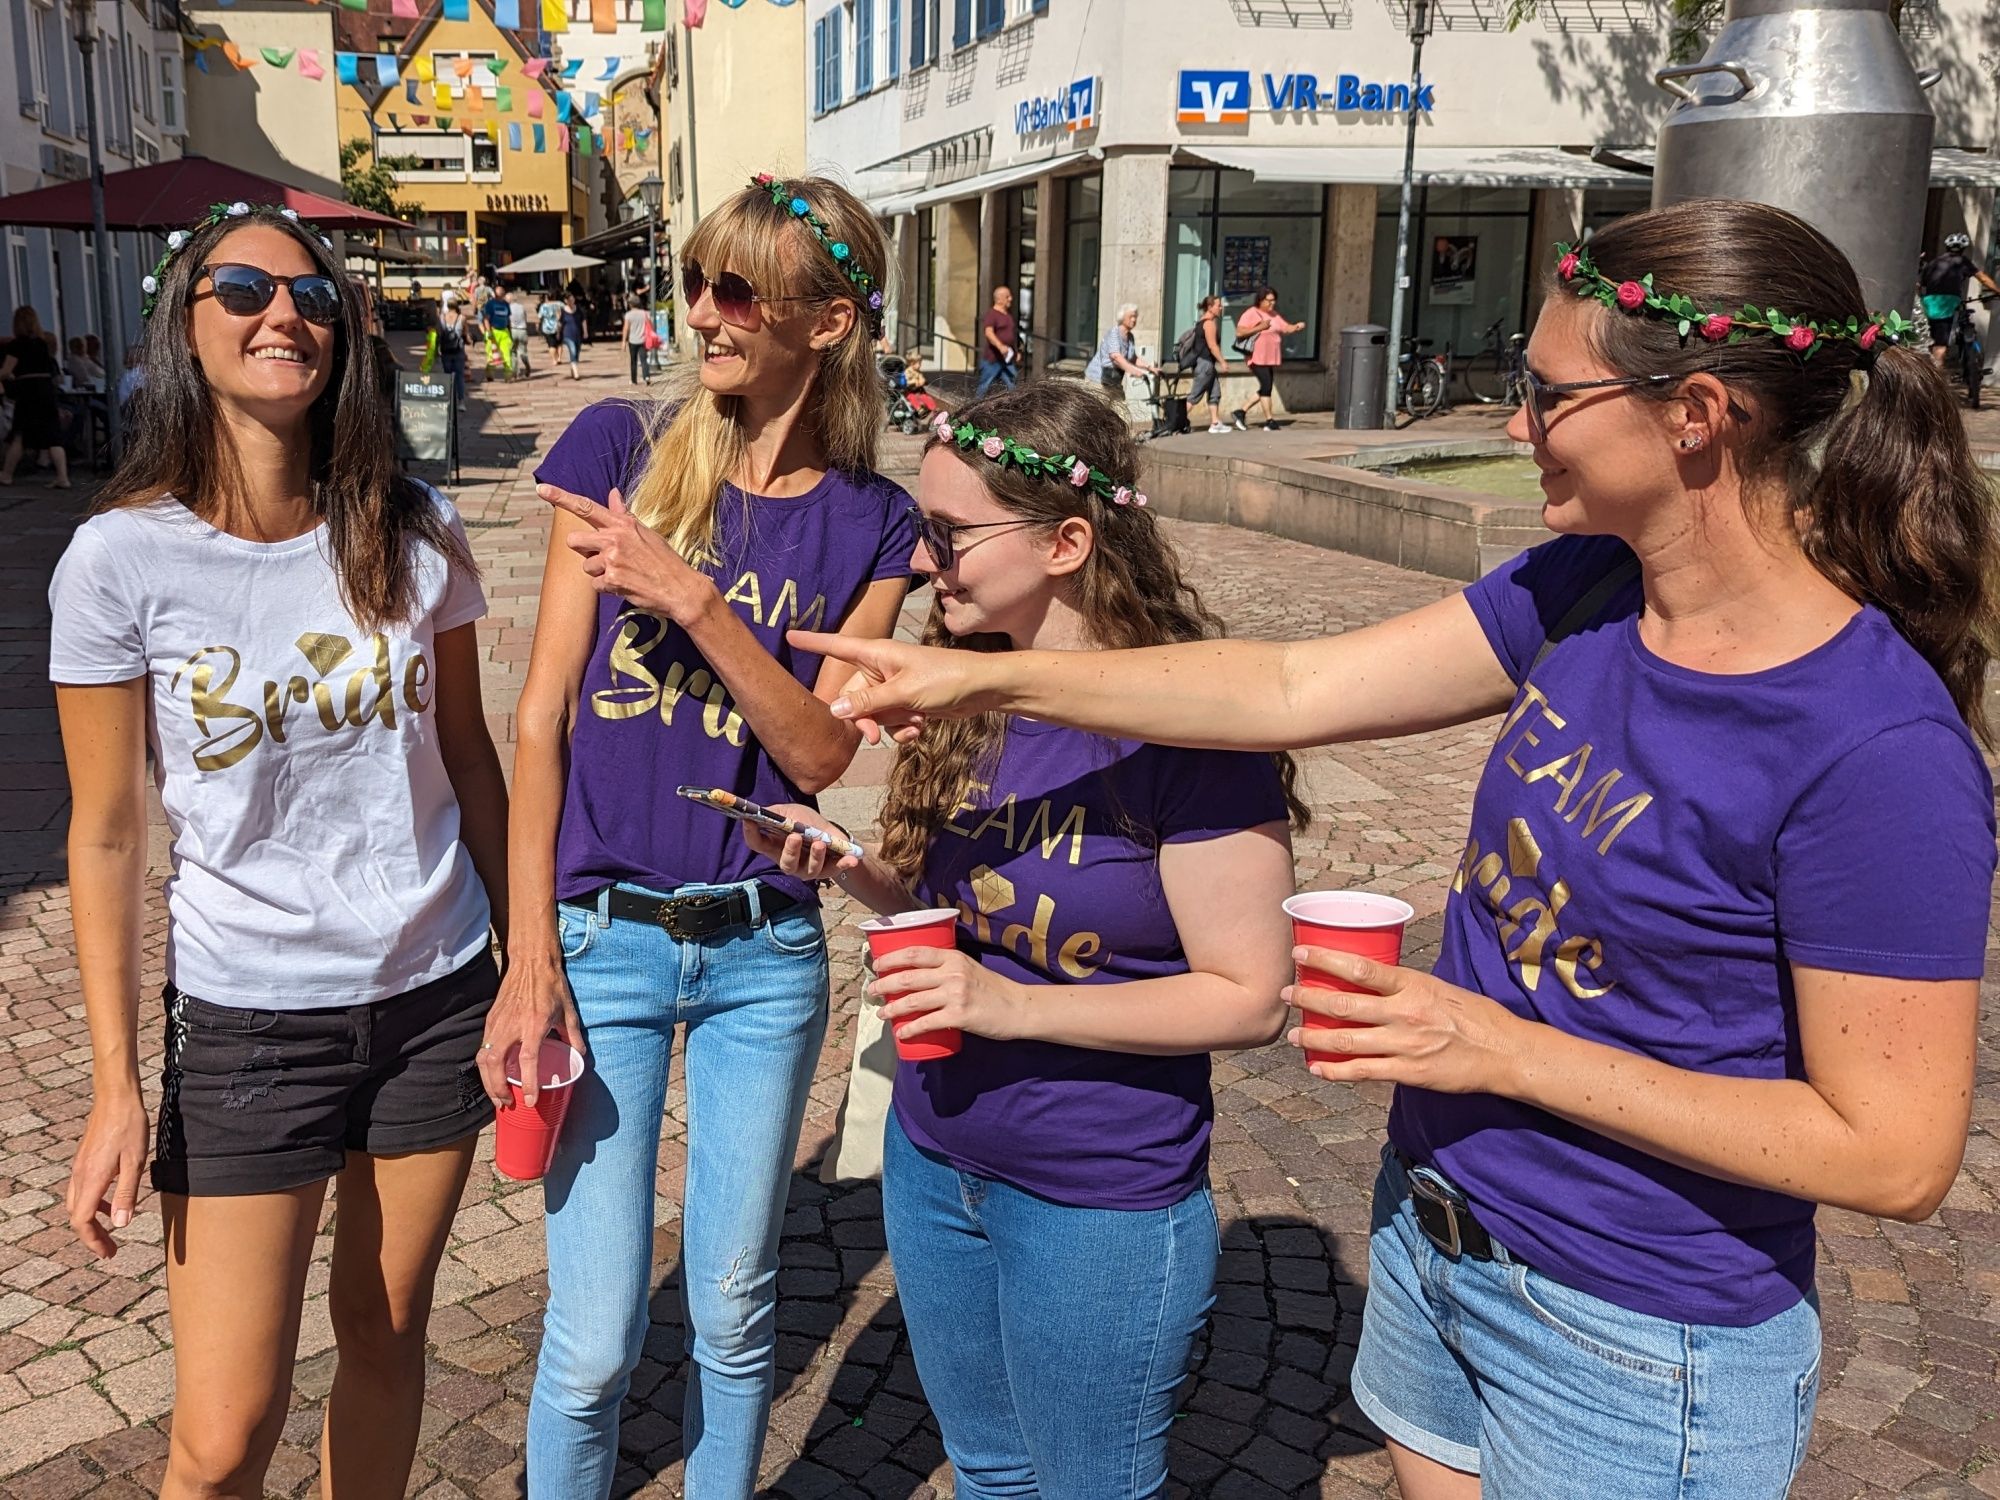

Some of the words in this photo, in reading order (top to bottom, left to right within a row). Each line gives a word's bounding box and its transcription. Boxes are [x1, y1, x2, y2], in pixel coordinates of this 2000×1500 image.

[1014, 86, 1065, 135] VR-Bank
[1263, 73, 1434, 112] VR-Bank
[170, 632, 434, 771] Bride
[591, 608, 748, 748] Bri
[943, 779, 1086, 865] EAM
[1500, 680, 1653, 856] TEAM
[1453, 837, 1616, 999] ride
